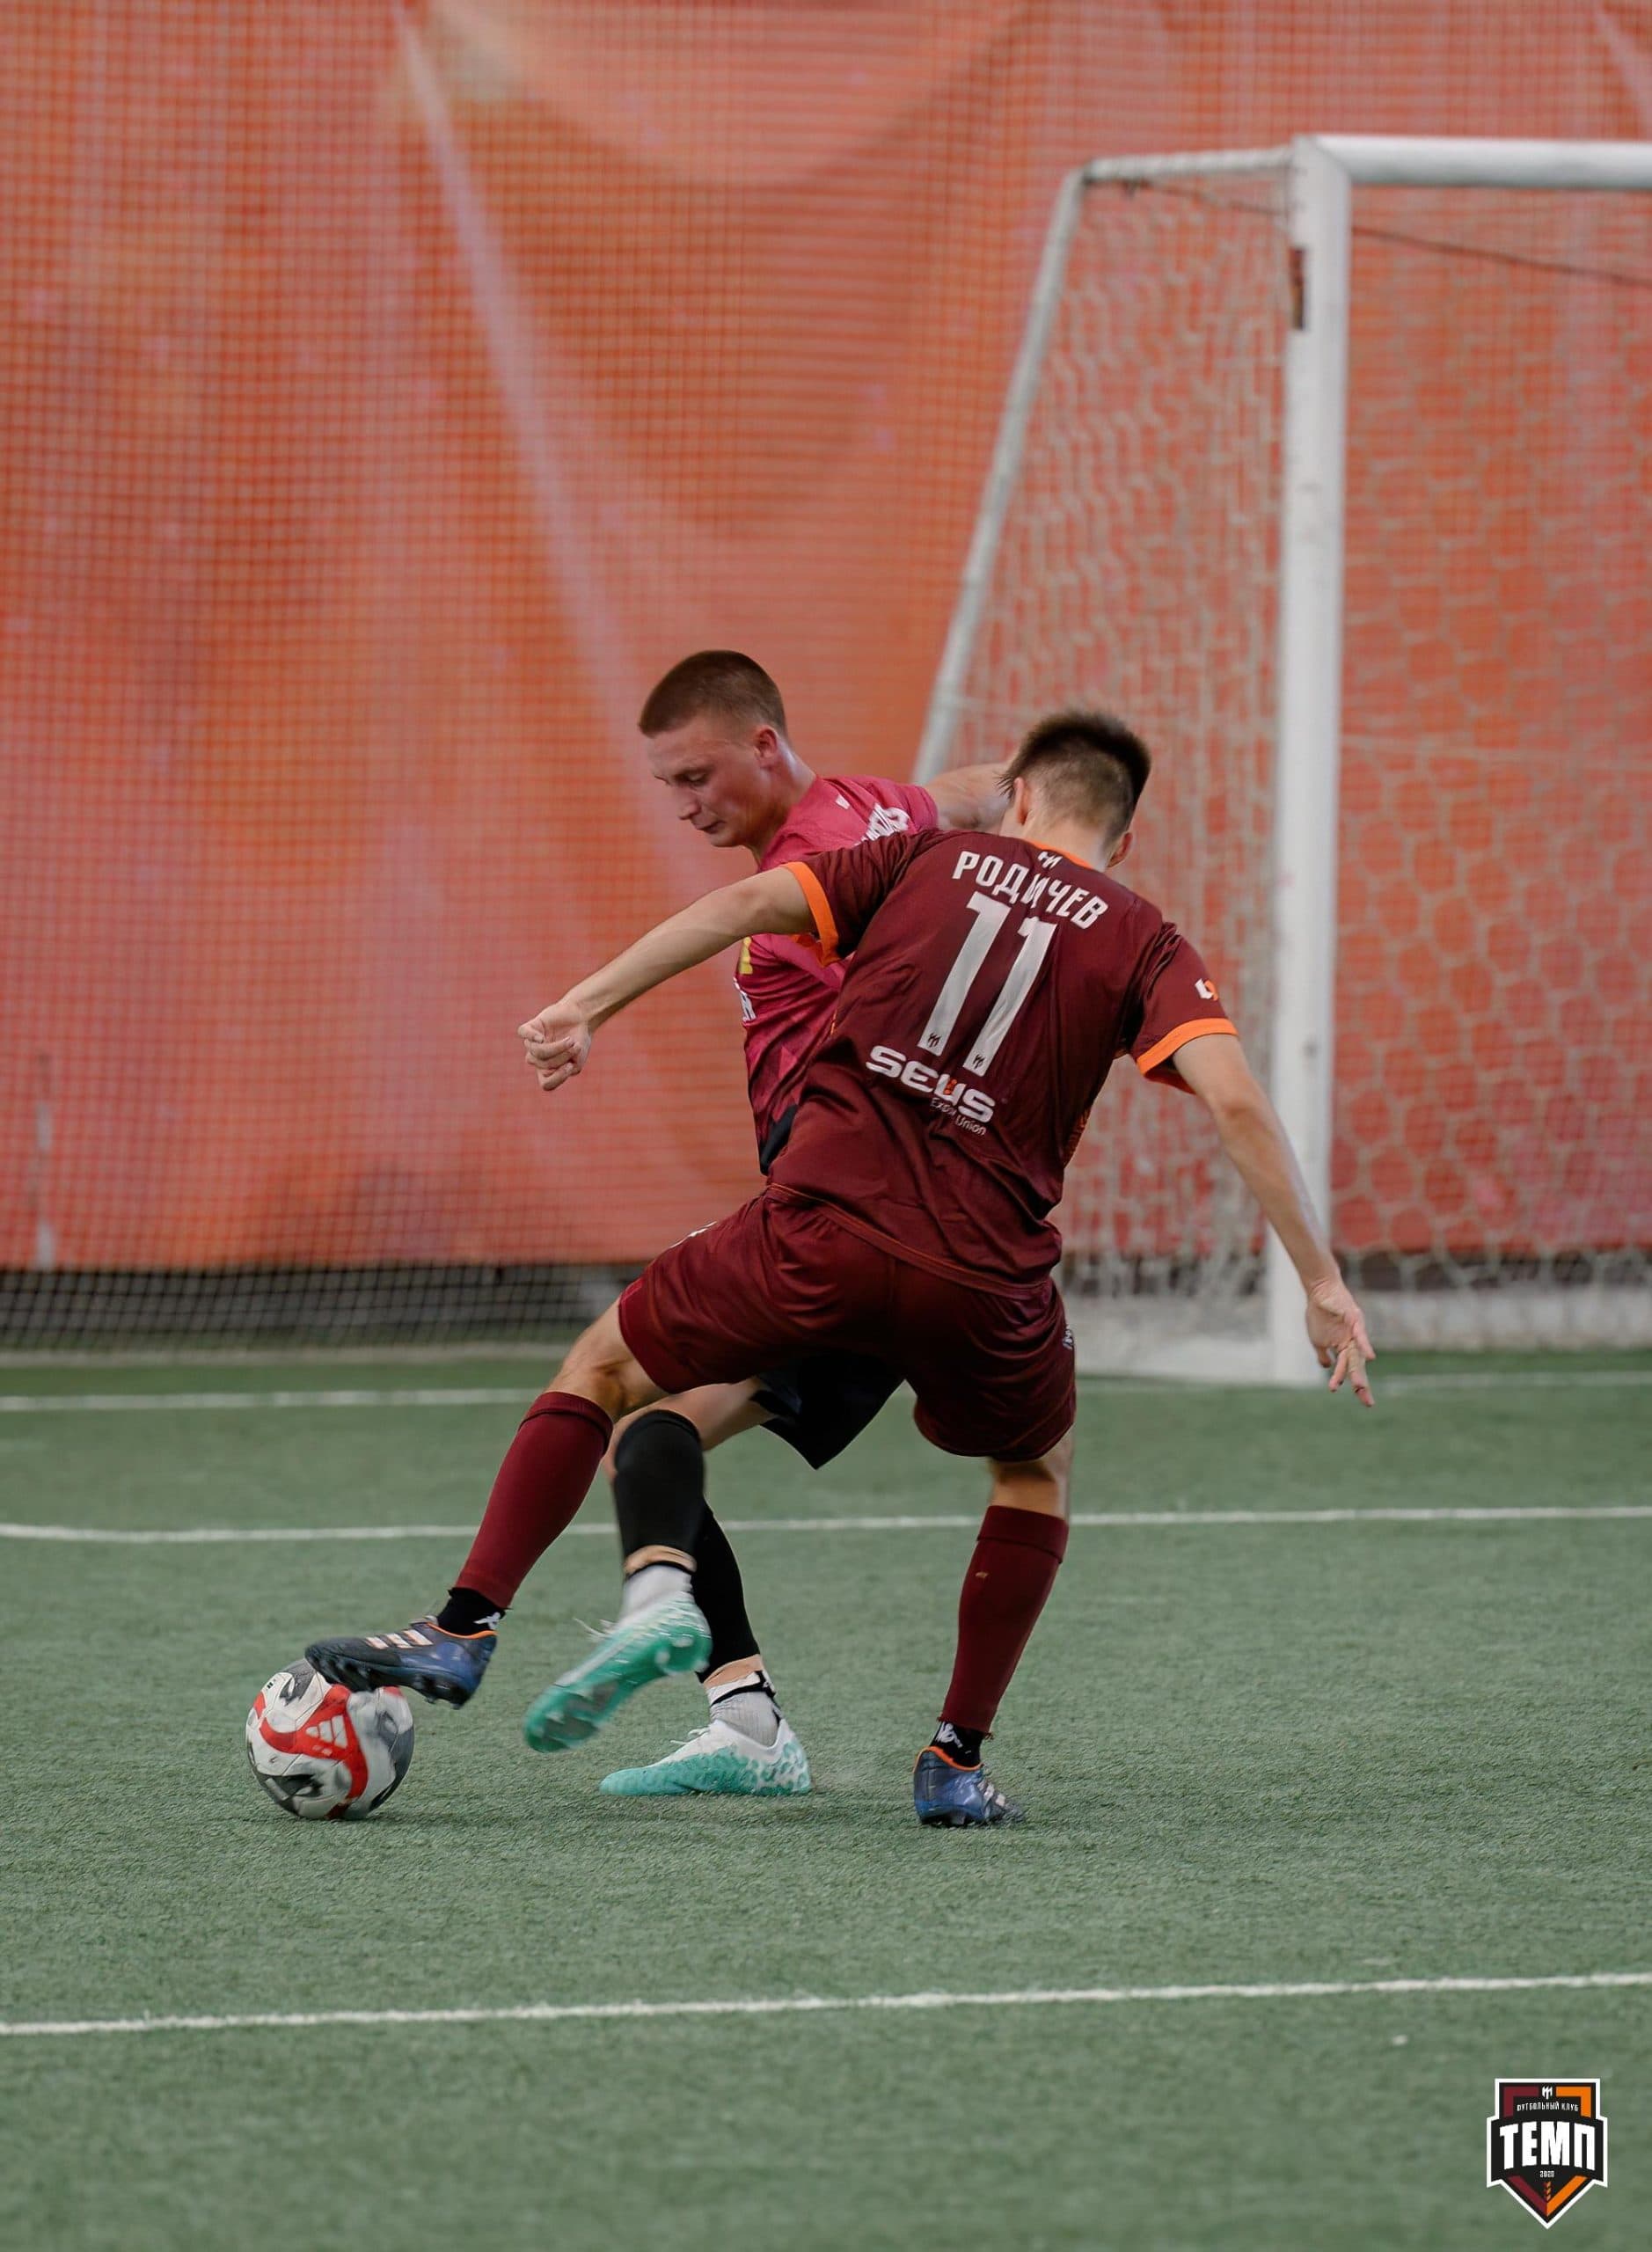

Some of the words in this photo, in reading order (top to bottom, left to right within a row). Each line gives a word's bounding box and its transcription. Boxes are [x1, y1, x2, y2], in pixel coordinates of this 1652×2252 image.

[952, 851, 1108, 929] РОДИЧЕВ
[917, 891, 1057, 1077] 11
[866, 1045, 996, 1123] SEUS
[955, 1115, 987, 1136] Union
